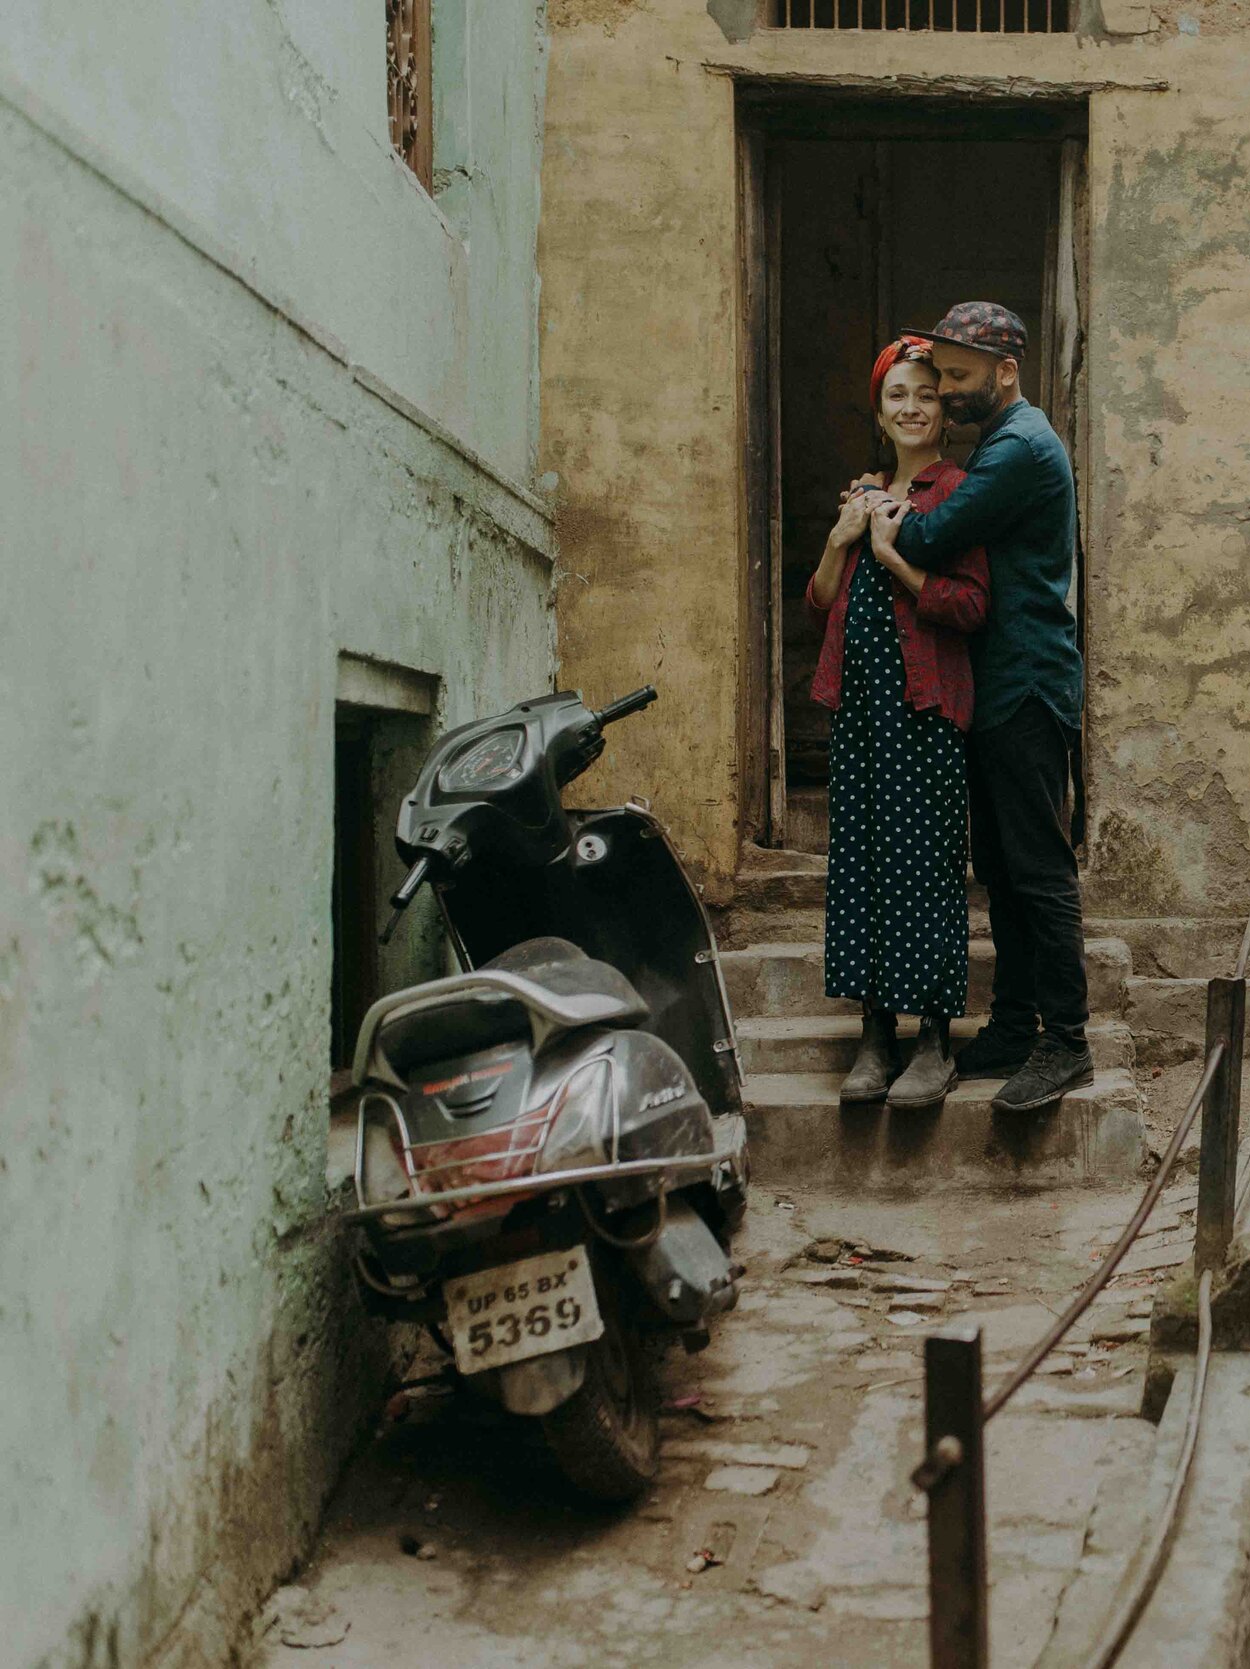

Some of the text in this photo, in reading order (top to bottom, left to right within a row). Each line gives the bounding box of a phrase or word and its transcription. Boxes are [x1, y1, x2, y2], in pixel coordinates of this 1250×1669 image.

[467, 1271, 568, 1314] UP 65 BX
[468, 1296, 582, 1357] 5369
